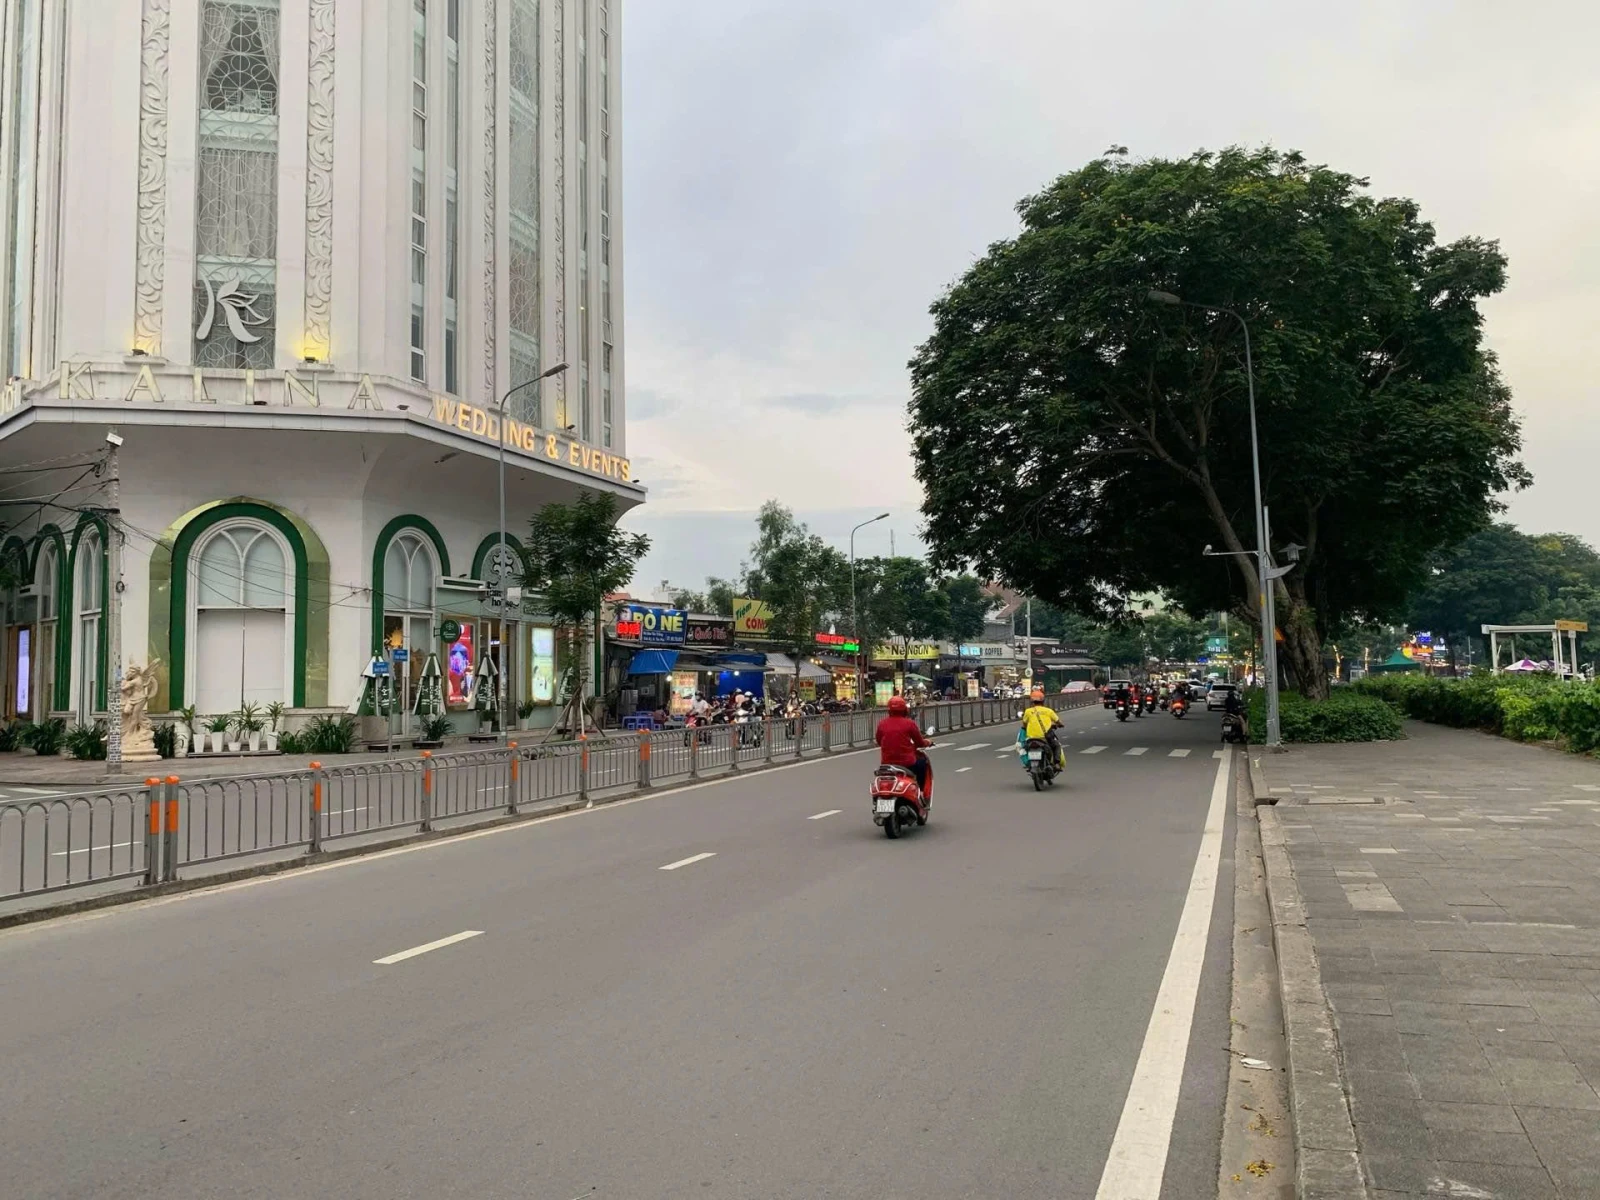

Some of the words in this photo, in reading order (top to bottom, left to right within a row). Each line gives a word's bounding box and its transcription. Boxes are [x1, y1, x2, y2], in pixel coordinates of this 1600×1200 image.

[59, 360, 384, 411] KALINA
[432, 394, 535, 452] WEDDING
[545, 433, 559, 460] &
[569, 440, 631, 482] EVENTS
[660, 611, 684, 633] NÉ
[985, 647, 1003, 655] COFFEE
